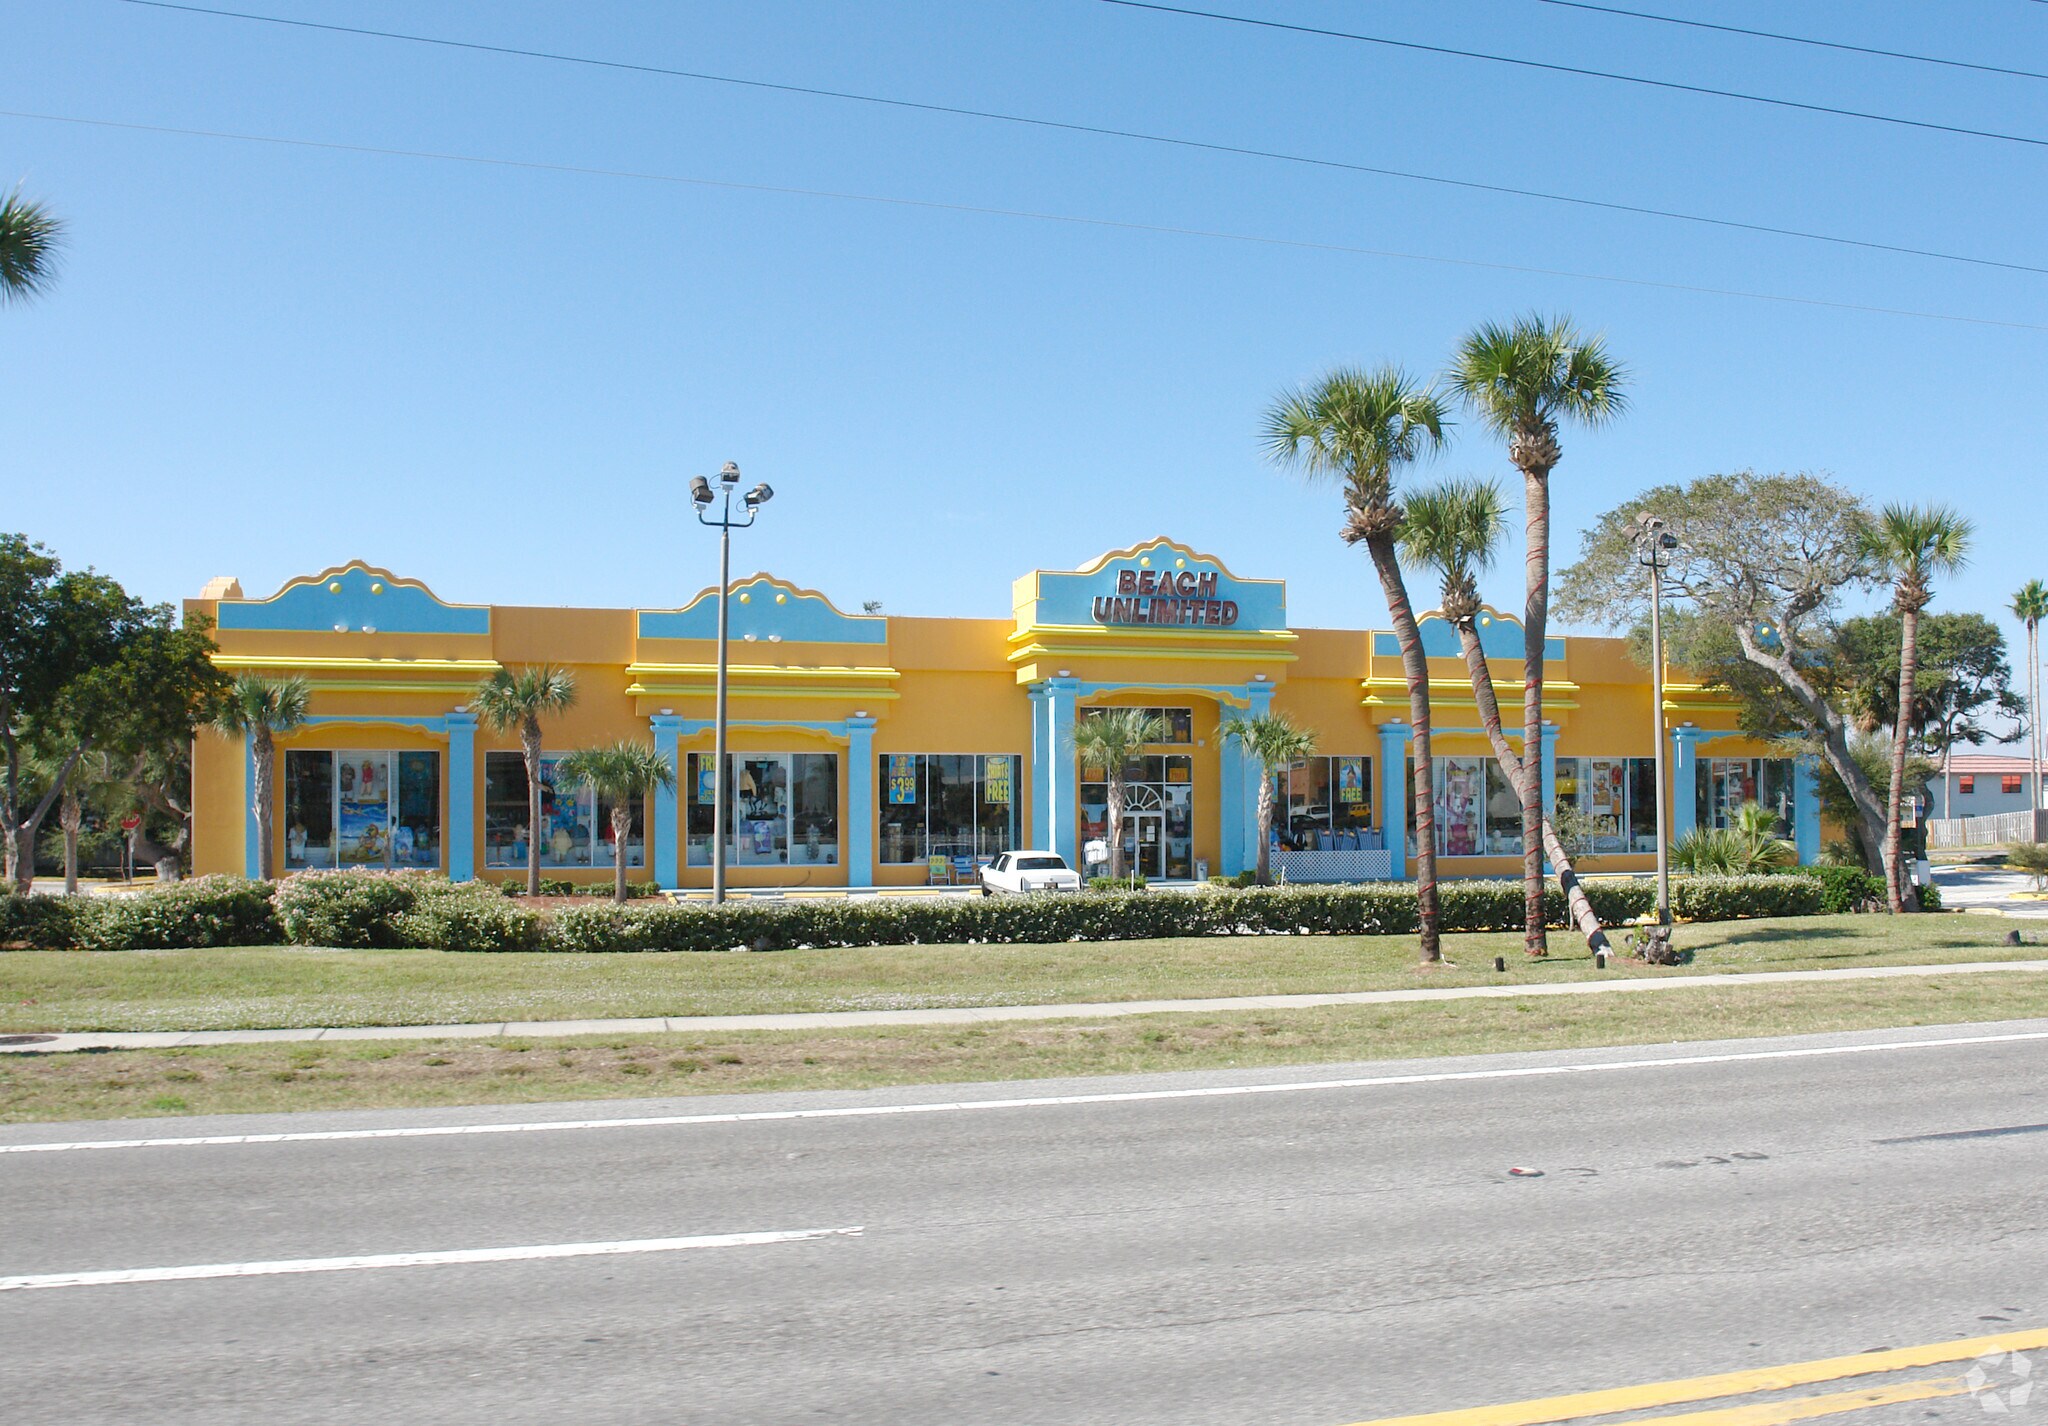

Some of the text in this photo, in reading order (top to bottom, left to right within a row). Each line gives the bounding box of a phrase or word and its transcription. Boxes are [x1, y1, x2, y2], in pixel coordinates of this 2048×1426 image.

[1116, 569, 1218, 597] BEACH
[1092, 596, 1239, 626] UNLIMITED
[987, 780, 1008, 802] FREE
[1341, 787, 1361, 802] FREE
